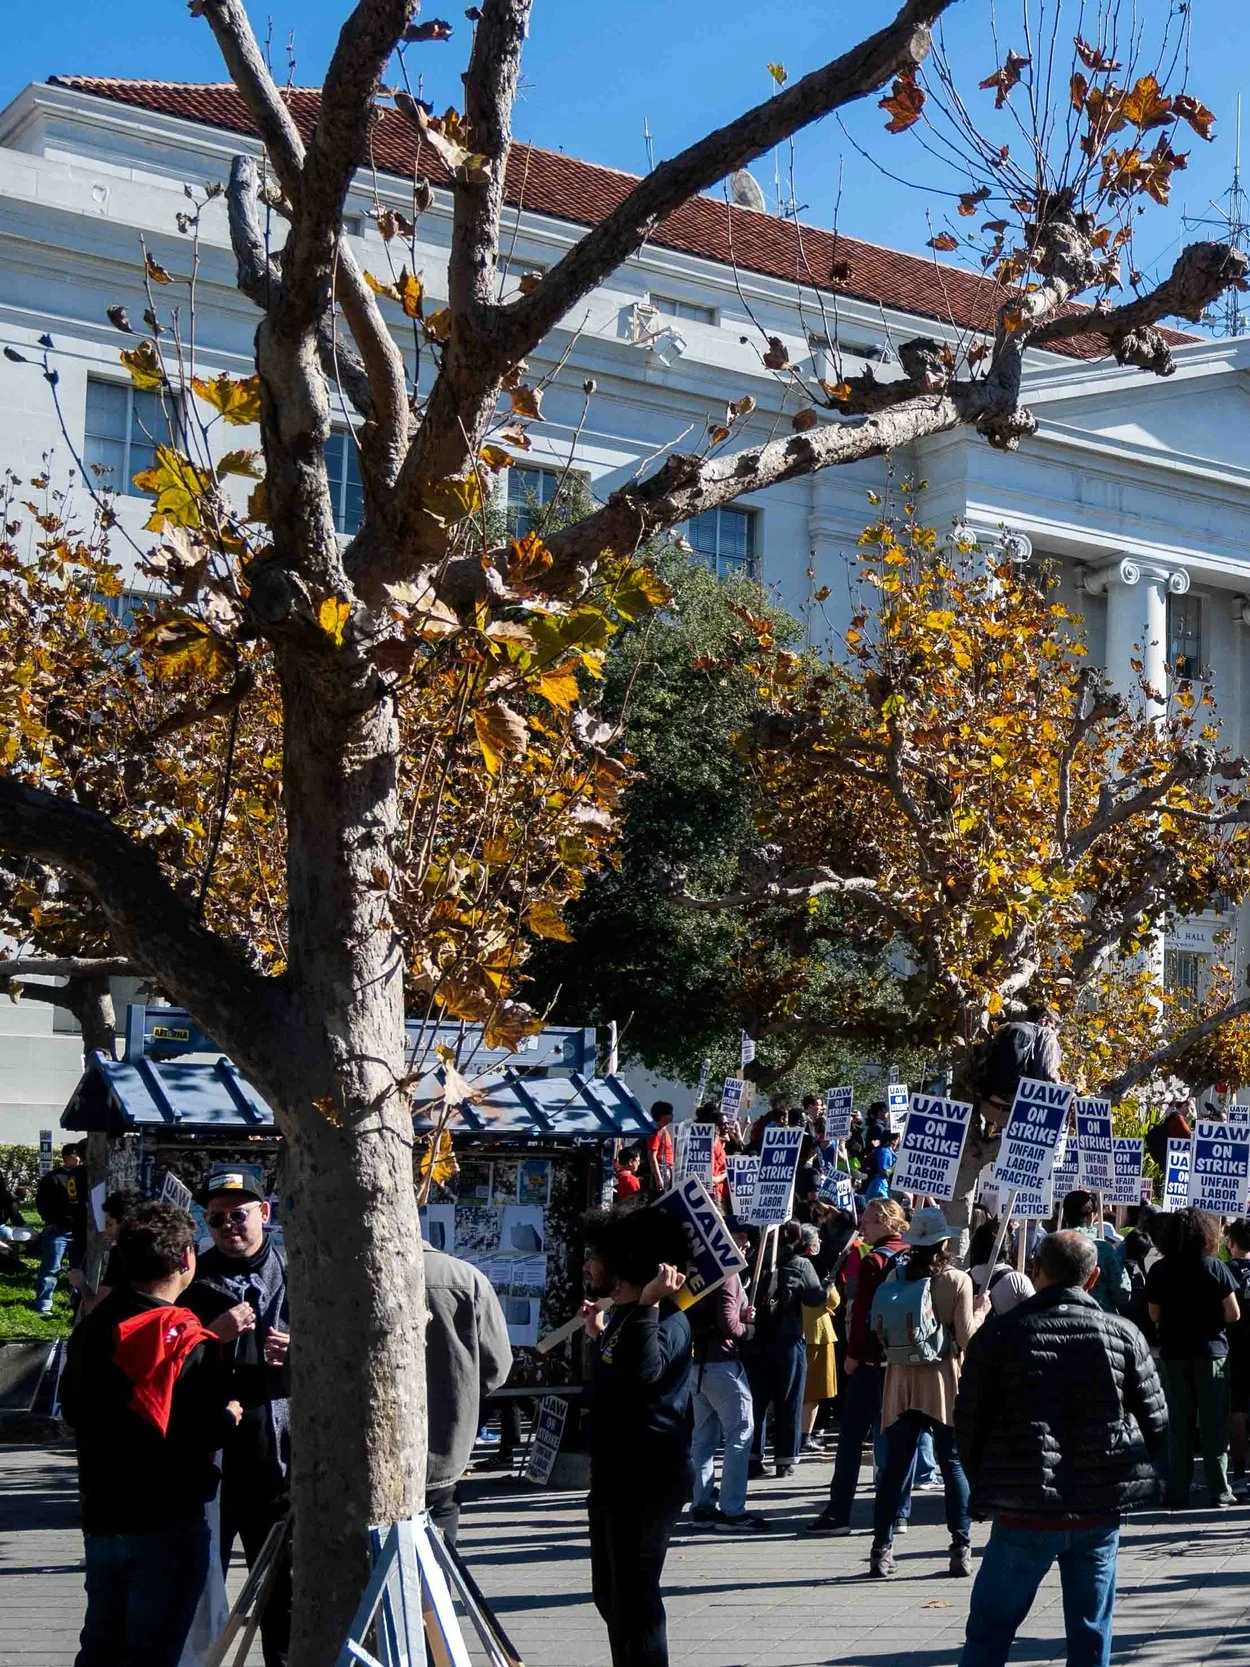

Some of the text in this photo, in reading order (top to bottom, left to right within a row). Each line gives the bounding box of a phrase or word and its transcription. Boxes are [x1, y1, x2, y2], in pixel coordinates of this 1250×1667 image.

[1186, 932, 1205, 941] HALL
[726, 1080, 742, 1088] UAW
[828, 1088, 852, 1097] UAW
[1020, 1082, 1070, 1106] UAW
[828, 1108, 850, 1116] STRIKE
[912, 1098, 969, 1120] UAW
[1028, 1107, 1048, 1124] ON
[1077, 1102, 1109, 1116] UAW
[925, 1120, 947, 1136] ON
[1009, 1122, 1056, 1144] STRIKE
[1088, 1120, 1100, 1134] ON
[1198, 1124, 1250, 1141] UAW
[766, 1131, 801, 1146] UAW
[906, 1132, 960, 1156] STRIKE
[1079, 1135, 1110, 1150] STRIKE
[772, 1150, 786, 1164] ON
[1008, 1142, 1046, 1161] UNFAIR
[1212, 1144, 1232, 1158] ON
[908, 1152, 950, 1170] UNFAIR
[1006, 1156, 1040, 1174] LABOR
[1084, 1153, 1108, 1164] UNFAIR
[1116, 1154, 1130, 1163] ON
[760, 1166, 794, 1180] STRIKE
[907, 1164, 945, 1182] LABOR
[1086, 1165, 1108, 1176] LABOR
[1196, 1159, 1246, 1174] STRIKE
[896, 1174, 952, 1196] PRACTICE
[995, 1169, 1044, 1189] PRACTICE
[1082, 1175, 1114, 1188] PRACTICE
[1201, 1176, 1239, 1188] UNFAIR
[166, 1176, 190, 1206] UAW
[760, 1184, 786, 1195] UNFAIR
[1202, 1189, 1236, 1200] LABOR
[758, 1196, 782, 1206] LABOR
[1193, 1199, 1244, 1212] PRACTICE
[751, 1208, 786, 1220] PRACTICE
[684, 1179, 740, 1267] UAW
